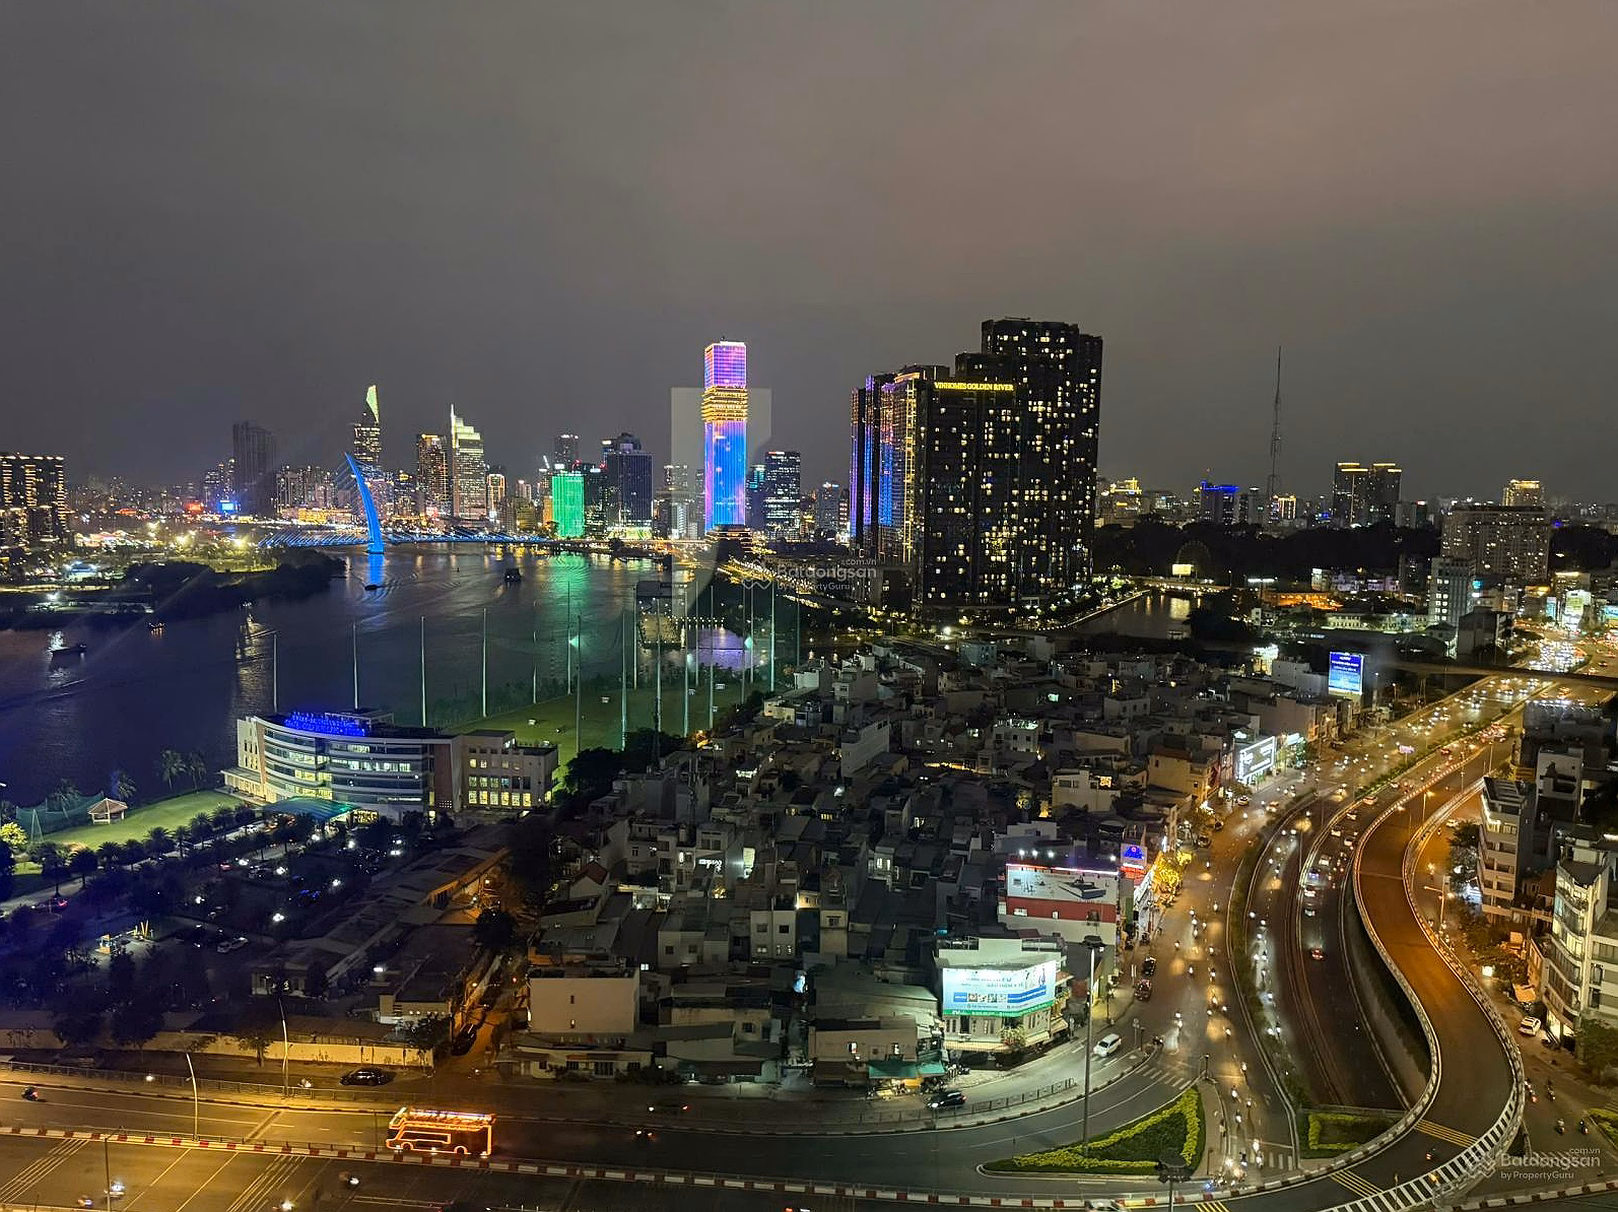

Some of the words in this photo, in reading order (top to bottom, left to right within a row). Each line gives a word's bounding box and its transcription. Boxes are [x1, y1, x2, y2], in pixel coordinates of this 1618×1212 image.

[933, 381, 967, 390] VINHOMES
[966, 383, 993, 391] GOLDEN
[993, 383, 1014, 391] RIVER
